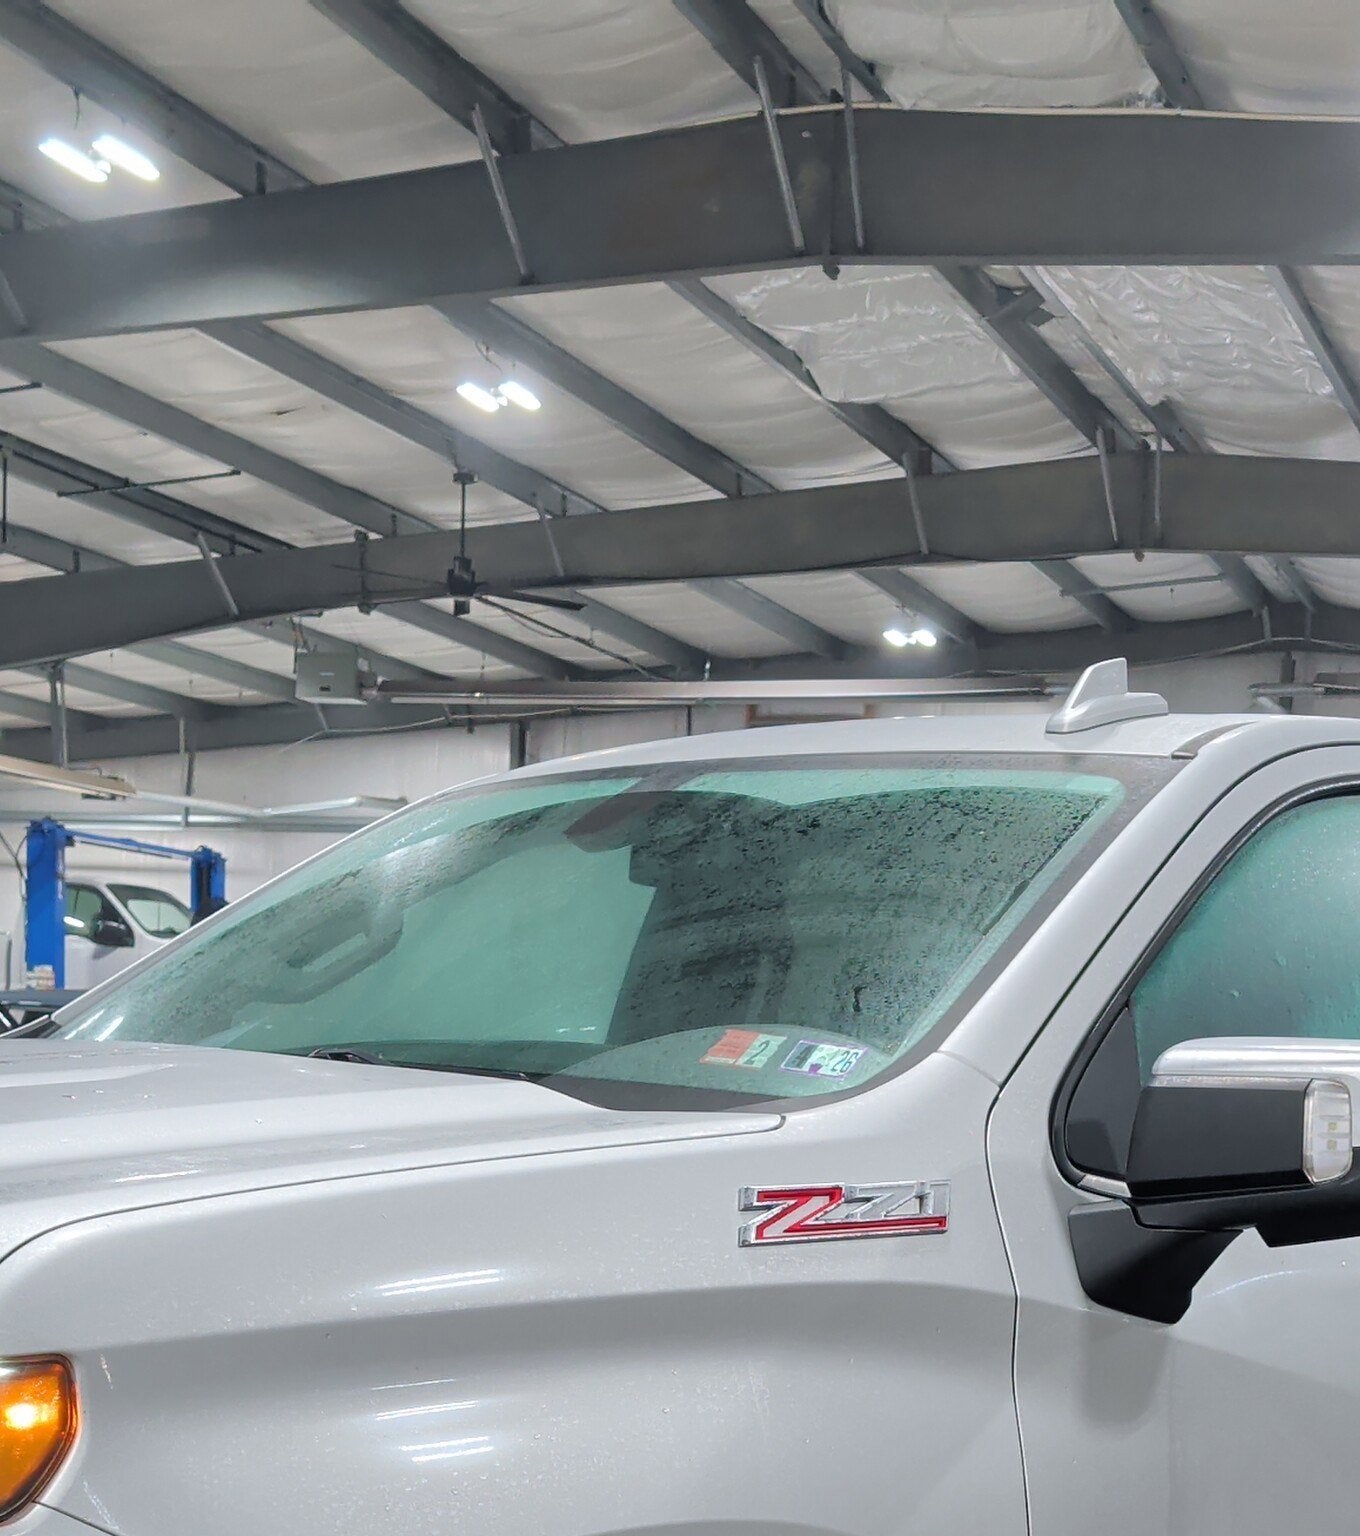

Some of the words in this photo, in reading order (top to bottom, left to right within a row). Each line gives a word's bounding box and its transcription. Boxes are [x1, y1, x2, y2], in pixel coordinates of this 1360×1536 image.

[744, 1040, 771, 1065] 2
[831, 1049, 859, 1073] 26
[738, 1179, 951, 1247] Z71
